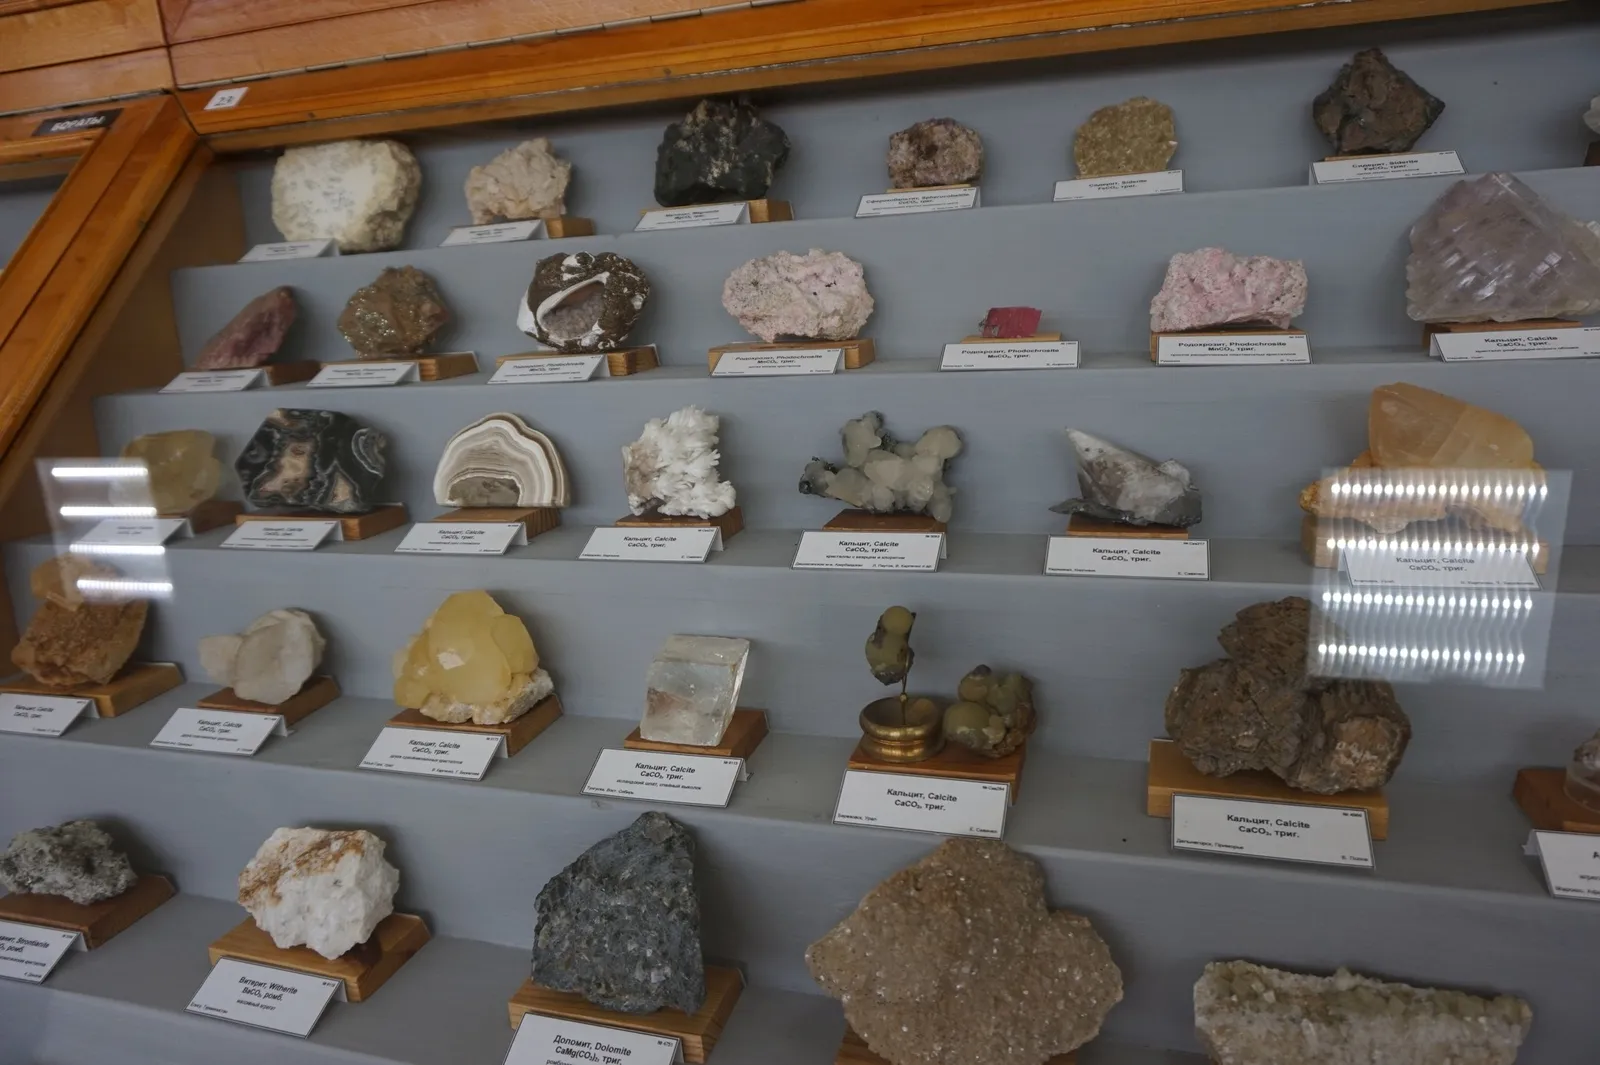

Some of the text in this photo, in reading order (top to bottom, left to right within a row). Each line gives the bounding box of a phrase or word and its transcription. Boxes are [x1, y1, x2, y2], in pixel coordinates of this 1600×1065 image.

[50, 116, 106, 132] БОРАТЫ
[1132, 548, 1162, 556] Calcite
[1396, 556, 1440, 564] Кальцит,
[408, 739, 461, 750] Кальцит, Calcite
[433, 748, 450, 756] триг.
[634, 762, 696, 774] Кальцит, Calcite
[886, 788, 958, 802] Кальцит, Calcite
[924, 803, 946, 812] триг.
[1226, 814, 1311, 830] Кальцит, Calcite
[1238, 825, 1300, 839] CaCO₃, триг.
[238, 976, 298, 995] Витерит, Witherite
[262, 992, 284, 1002] ромб.
[553, 1034, 632, 1057] Доломит, Dolomite
[602, 1056, 622, 1065] триг.
